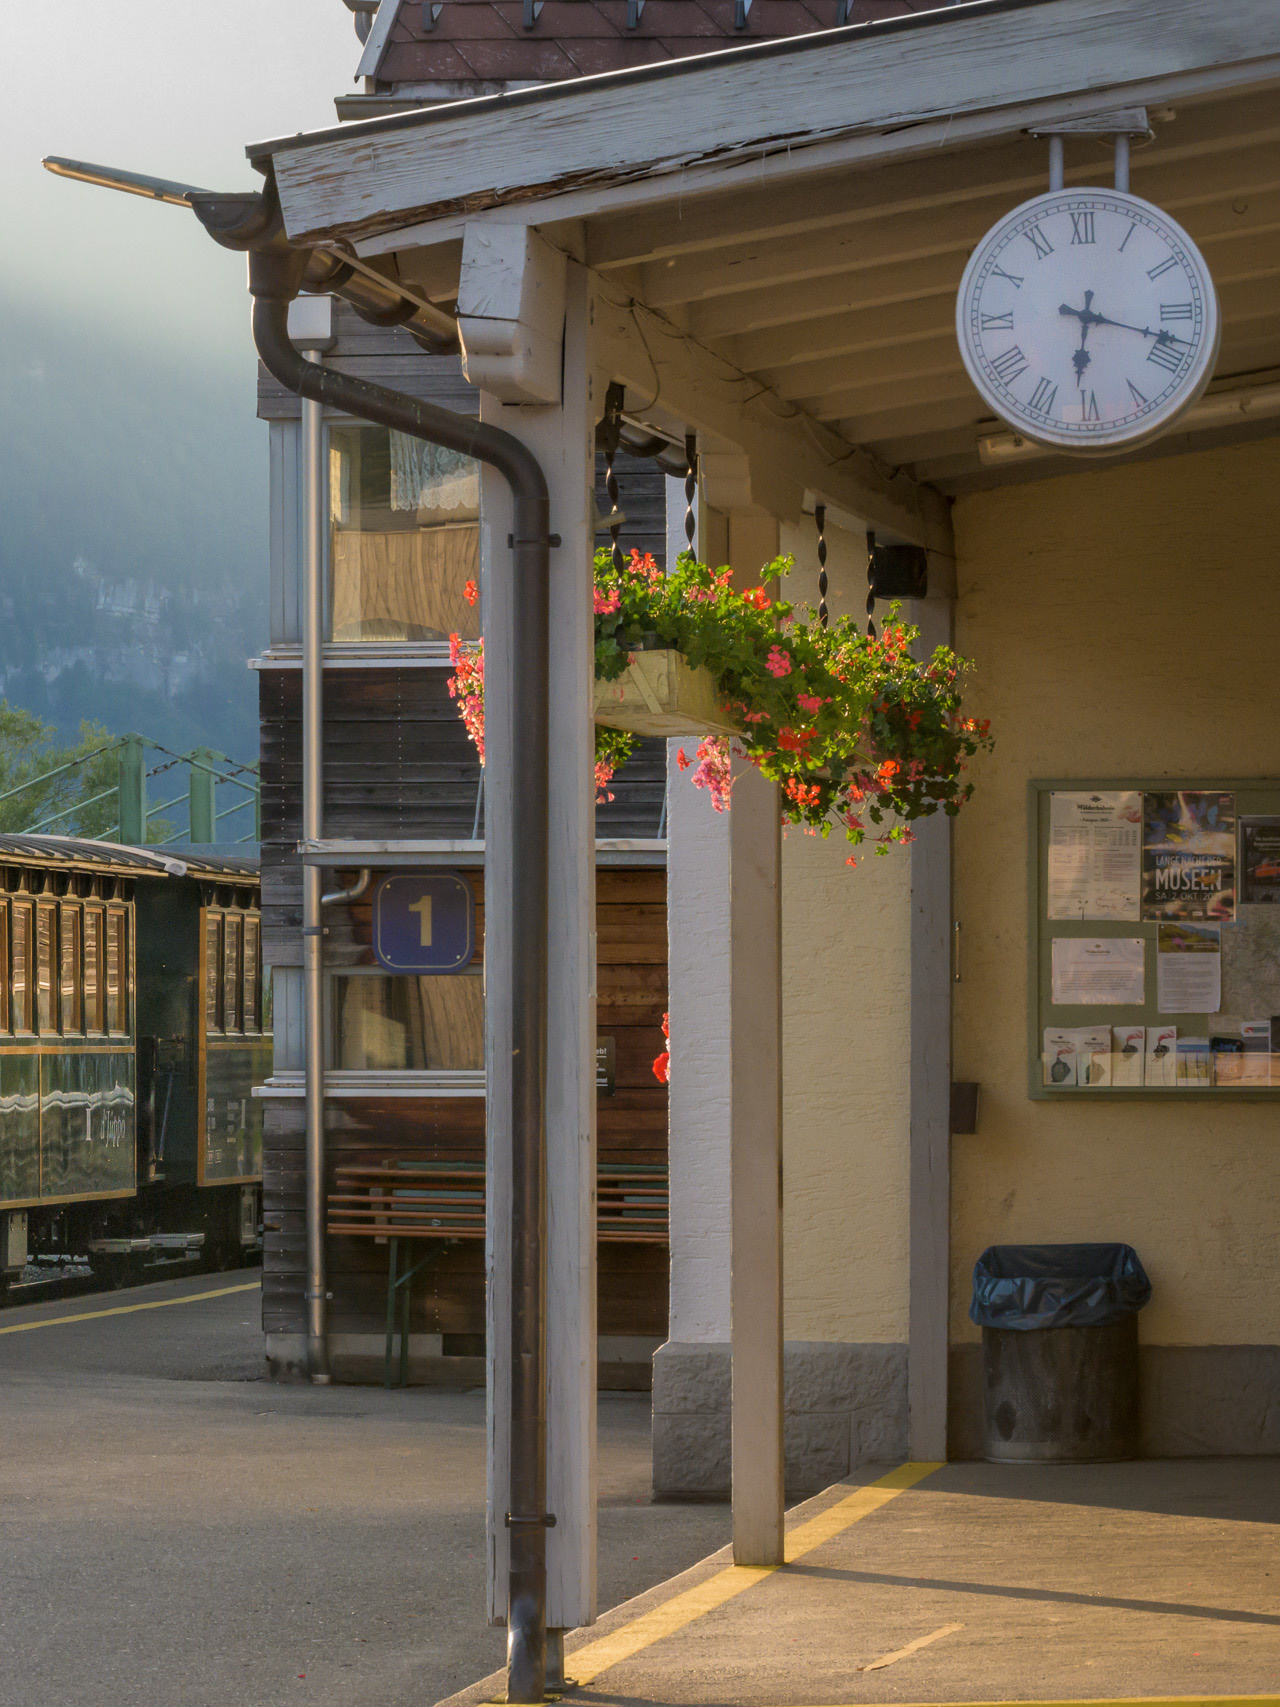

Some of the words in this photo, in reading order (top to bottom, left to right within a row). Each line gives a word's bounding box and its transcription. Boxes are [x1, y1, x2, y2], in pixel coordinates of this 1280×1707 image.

[1022, 224, 1055, 260] XI
[1069, 211, 1097, 245] XII
[991, 263, 1025, 289] X
[1146, 255, 1179, 282] II
[981, 310, 1014, 330] IX
[1160, 302, 1192, 321] III
[989, 345, 1031, 387] VIII
[1027, 376, 1059, 415] VII
[1080, 389, 1100, 421] VI
[1125, 378, 1149, 408] V
[1155, 869, 1222, 890] MUSEEN
[408, 895, 432, 946] 1
